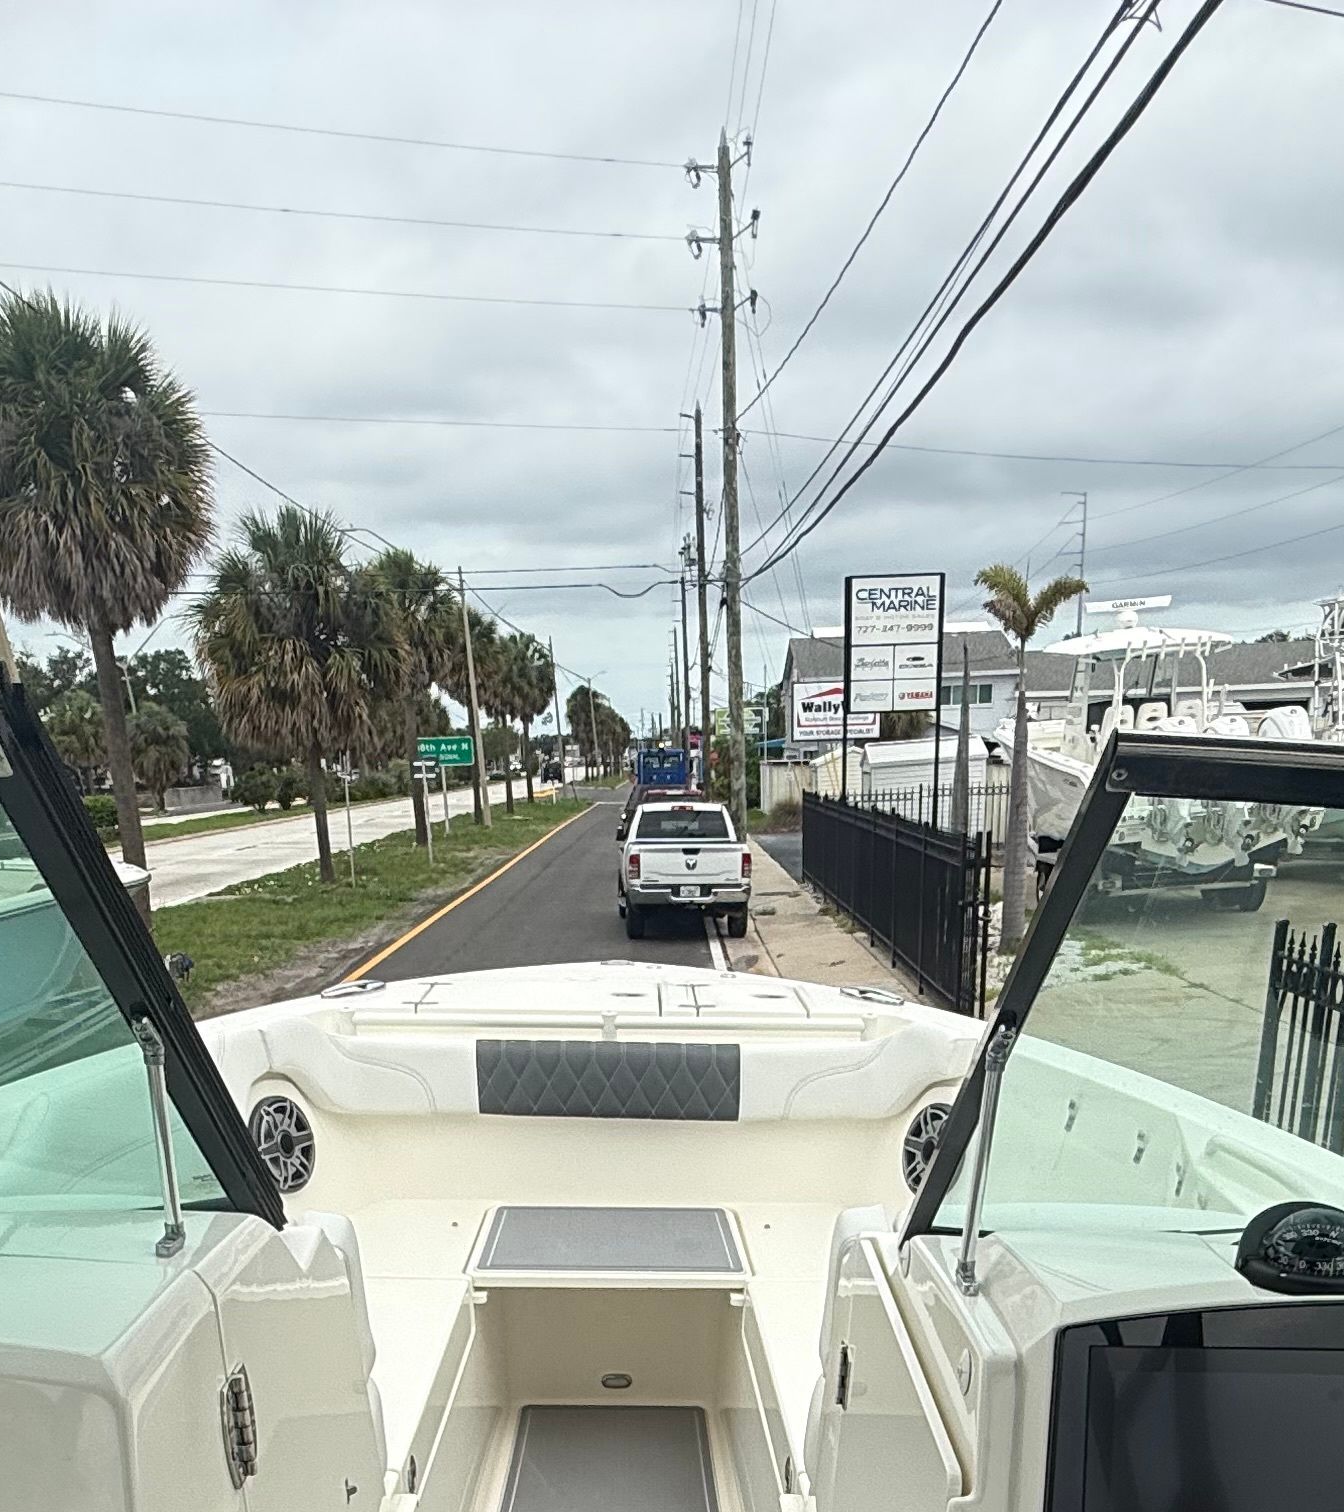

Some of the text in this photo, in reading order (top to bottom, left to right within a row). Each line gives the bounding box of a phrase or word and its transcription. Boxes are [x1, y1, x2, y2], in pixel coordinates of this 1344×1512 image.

[855, 586, 937, 601] CENTRAL
[871, 598, 937, 613] MARINE
[1111, 600, 1146, 609] GARMIN
[440, 742, 458, 752] Ave
